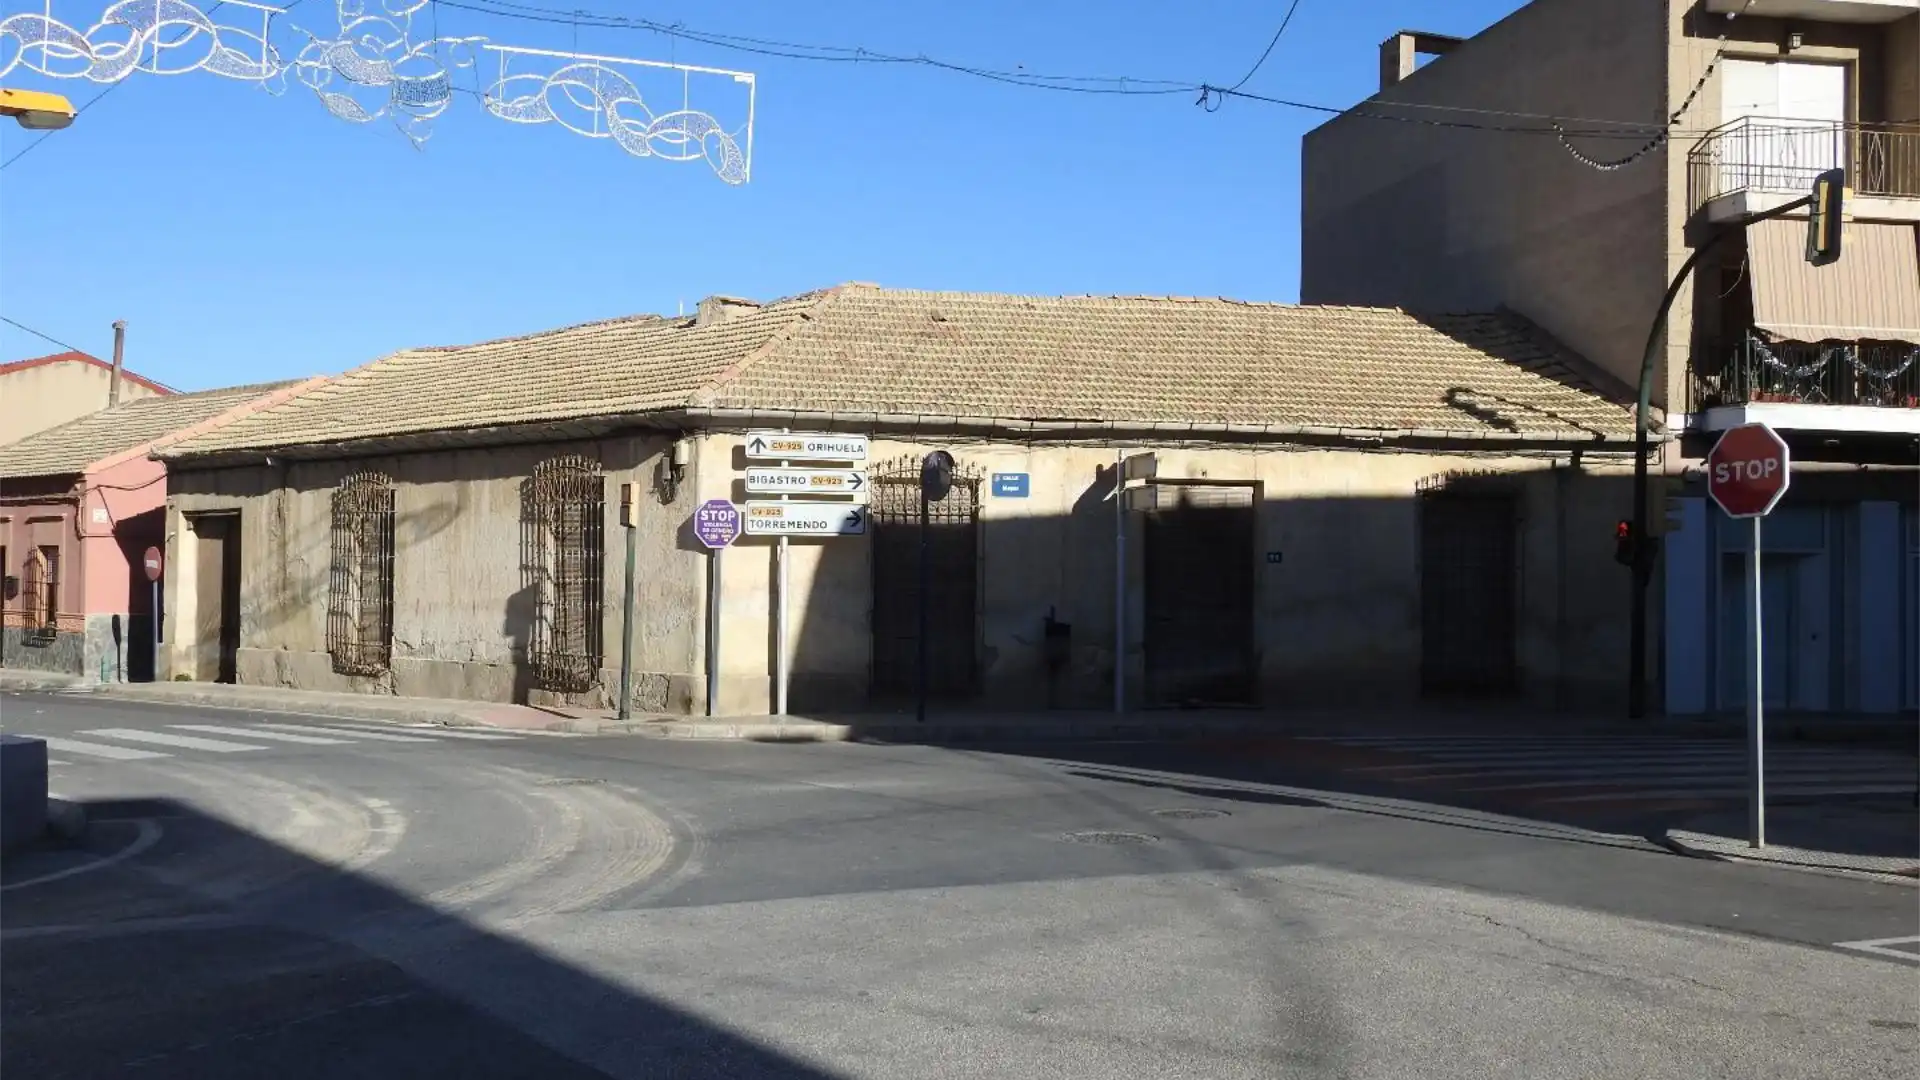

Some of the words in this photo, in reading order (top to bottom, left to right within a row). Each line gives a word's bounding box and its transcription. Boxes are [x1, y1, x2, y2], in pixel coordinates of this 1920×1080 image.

[807, 443, 864, 453] ORIHUELA
[1715, 457, 1778, 484] STOP
[749, 475, 807, 485] BIGASTRO
[700, 509, 736, 521] STOP
[749, 519, 828, 529] TORREMENDO
